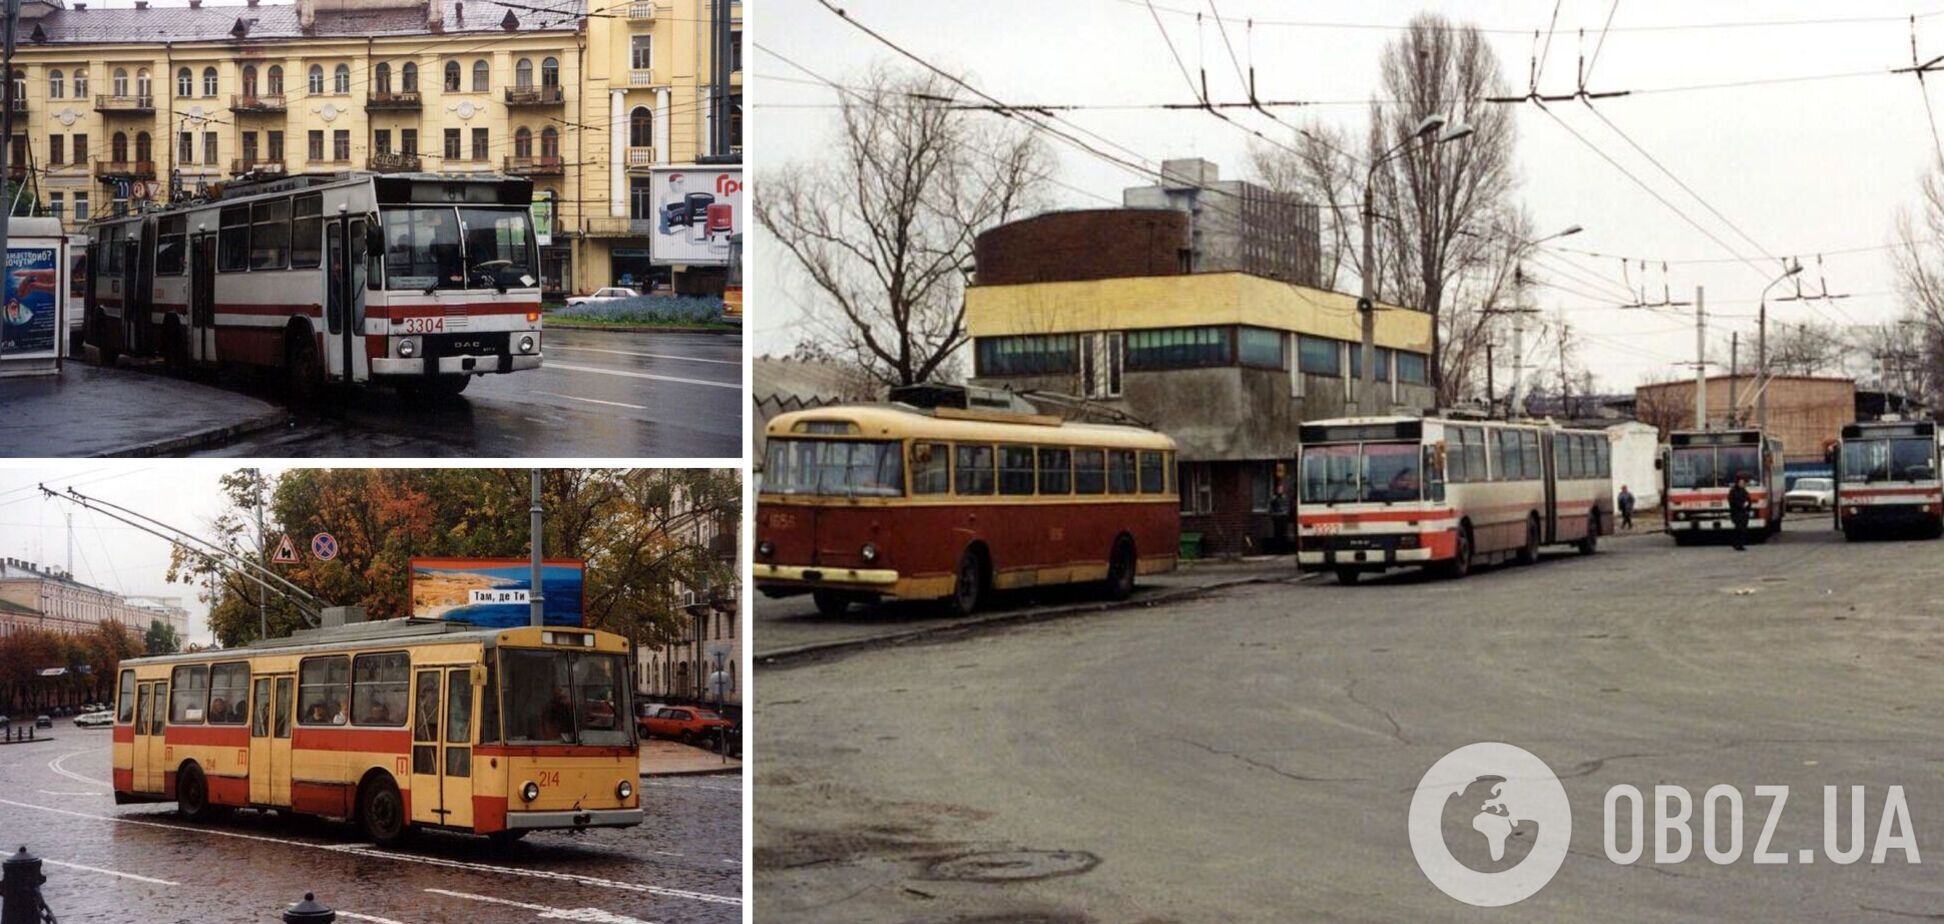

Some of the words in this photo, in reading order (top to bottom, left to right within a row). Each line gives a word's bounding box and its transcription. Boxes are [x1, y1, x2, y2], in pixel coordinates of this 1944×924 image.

[716, 174, 743, 197] Гр
[406, 317, 444, 333] 3304
[474, 591, 495, 602] Там,
[499, 592, 510, 602] де
[514, 591, 525, 601] Ти
[539, 771, 560, 787] 214
